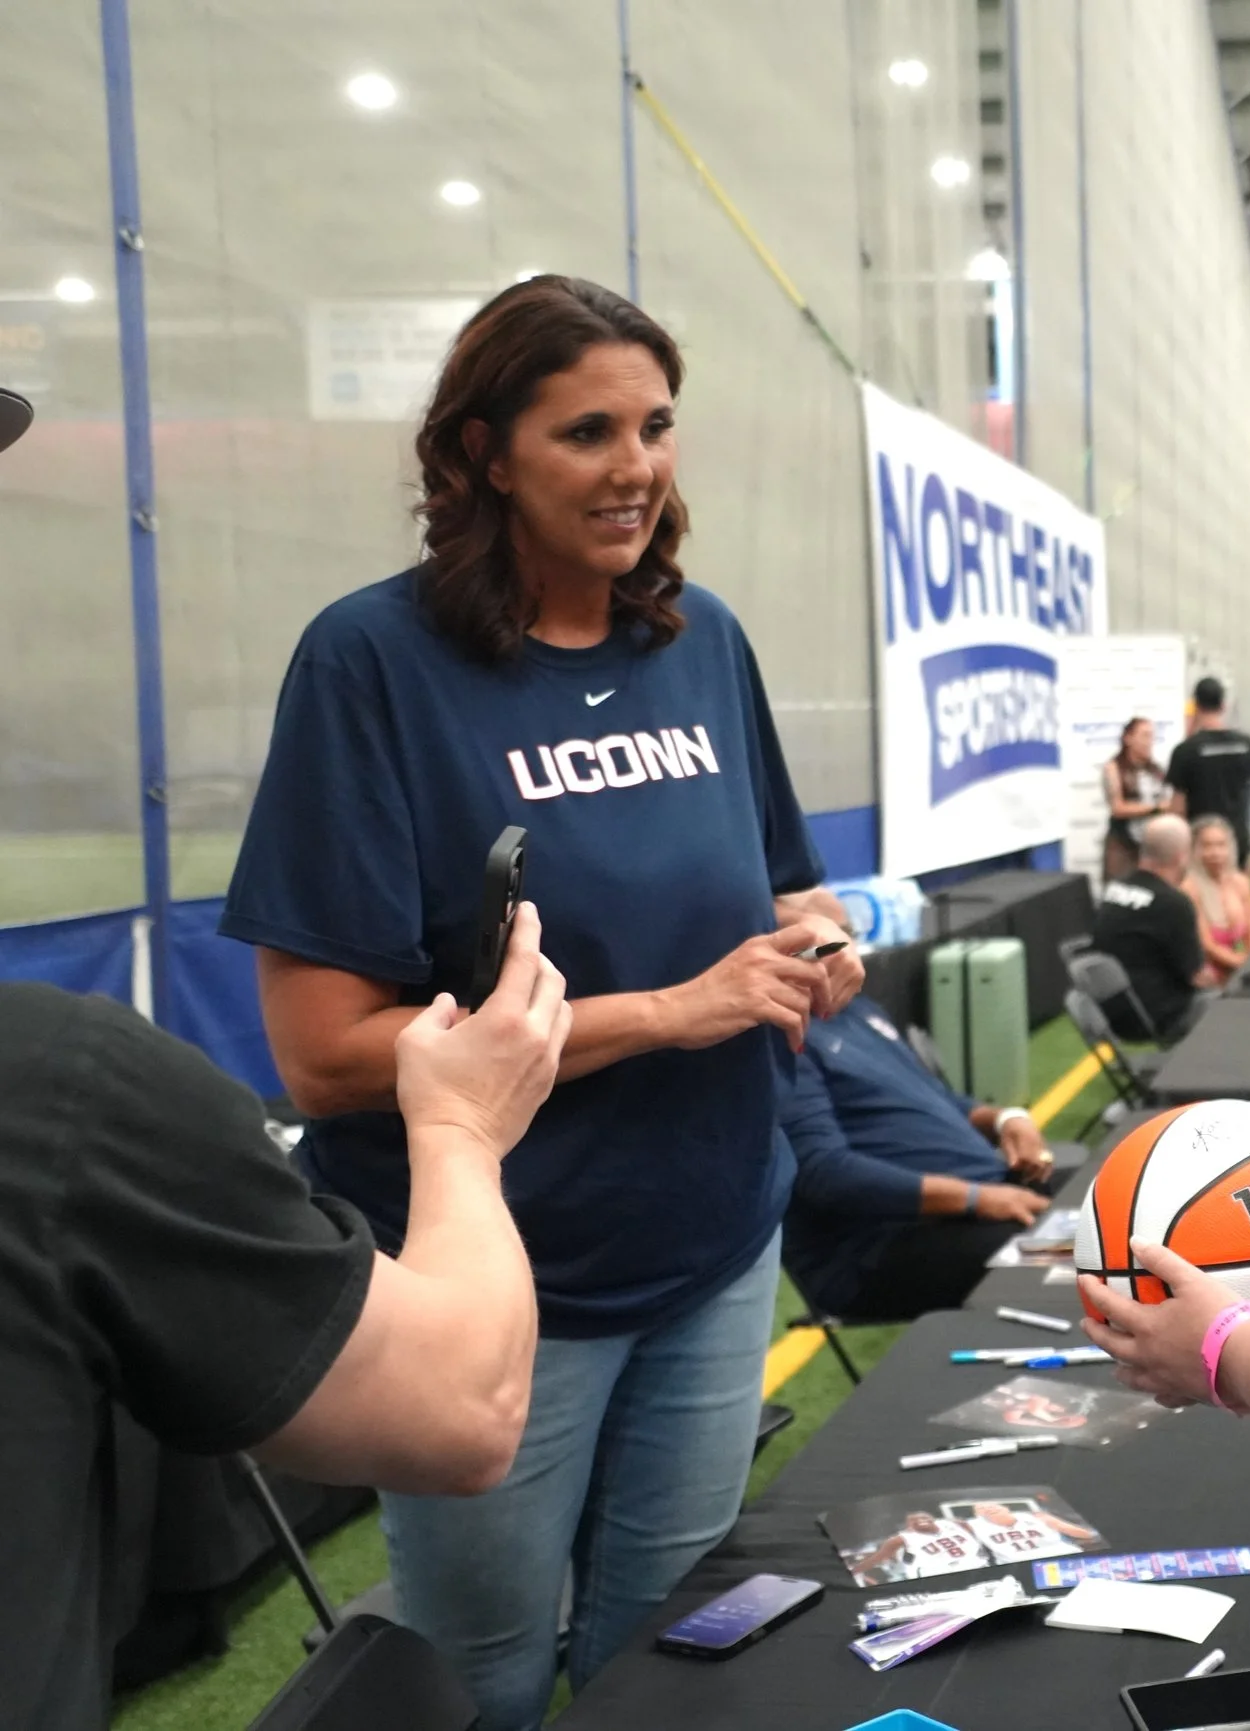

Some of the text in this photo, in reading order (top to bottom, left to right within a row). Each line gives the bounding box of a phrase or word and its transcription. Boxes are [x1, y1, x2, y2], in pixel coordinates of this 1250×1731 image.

[877, 450, 1094, 646] NORTHEAST
[507, 724, 721, 800] UCONN
[922, 1535, 966, 1555] USA
[991, 1530, 1043, 1544] USA
[1011, 1540, 1039, 1552] 11
